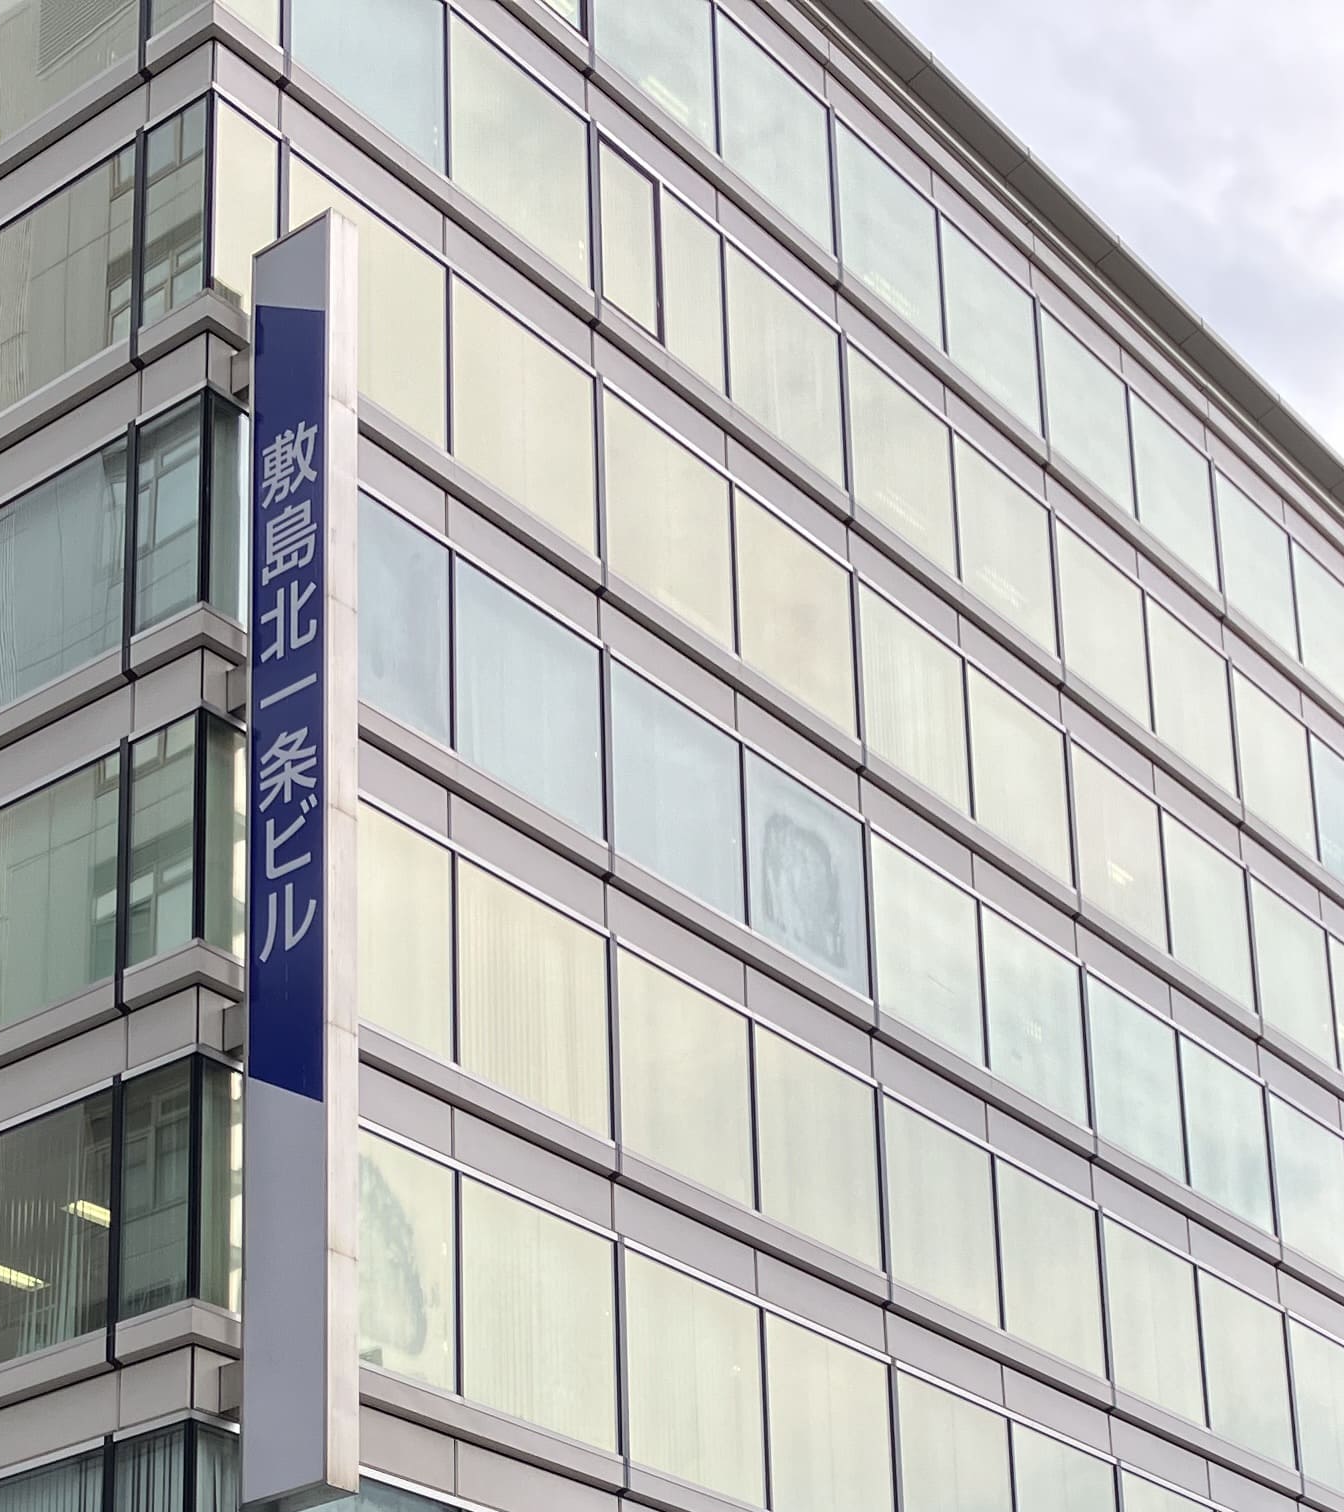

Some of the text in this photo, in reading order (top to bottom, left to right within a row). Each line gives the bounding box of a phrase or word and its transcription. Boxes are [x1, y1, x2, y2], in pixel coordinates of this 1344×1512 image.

[259, 420, 319, 964] 敷島北一条ビル
